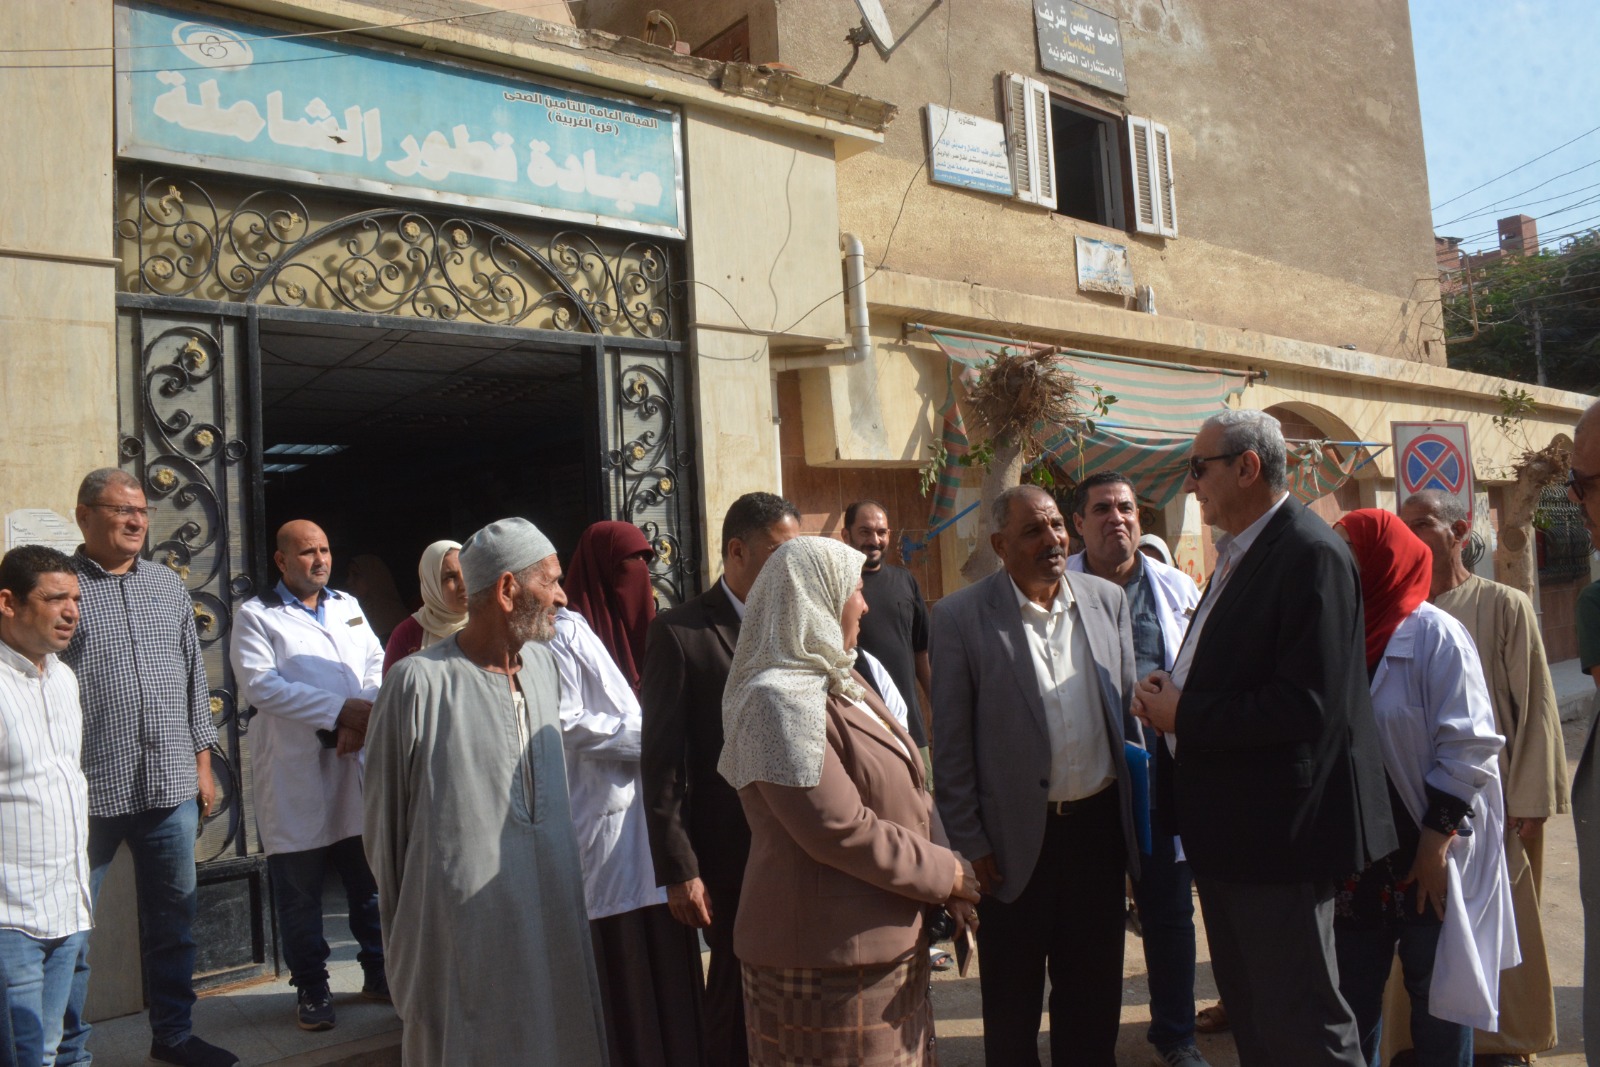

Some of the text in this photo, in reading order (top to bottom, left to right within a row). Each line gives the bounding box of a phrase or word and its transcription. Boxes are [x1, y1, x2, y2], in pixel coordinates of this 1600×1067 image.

[1038, 2, 1067, 29] شريف
[1070, 22, 1095, 41] عيسى
[1047, 42, 1079, 65] القانونية
[503, 91, 659, 129] الهيئة العامة للتأمين الصحى
[153, 70, 663, 213] عيادة قطور الشاملة
